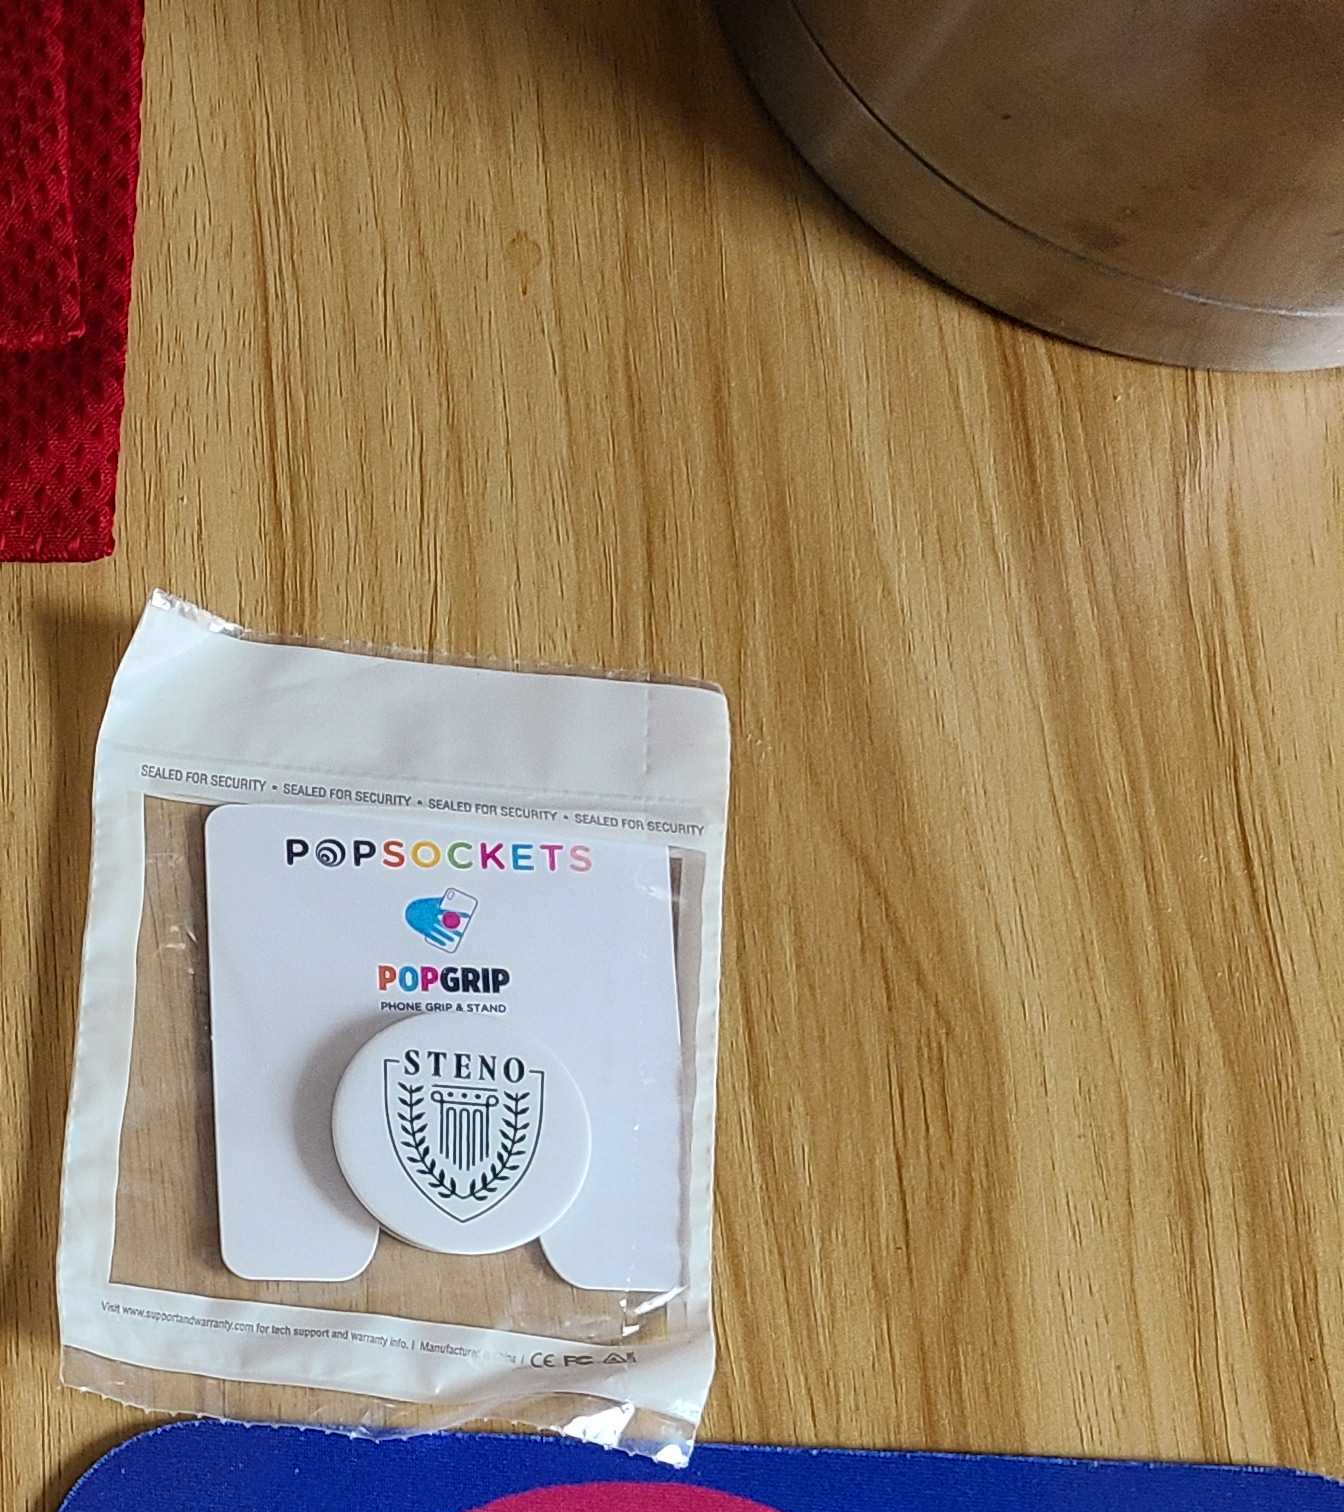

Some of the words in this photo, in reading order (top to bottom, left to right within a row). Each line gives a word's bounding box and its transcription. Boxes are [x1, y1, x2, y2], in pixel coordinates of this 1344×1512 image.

[141, 764, 183, 781] SEALED
[186, 772, 208, 785] FOR
[210, 774, 266, 792] SECURITY
[283, 784, 327, 798] SEALED
[329, 788, 352, 801] FOR
[354, 791, 412, 808] SECURITY
[428, 798, 472, 813] SEALED
[475, 803, 498, 816] FOR
[501, 805, 558, 821] SECURITY
[575, 813, 618, 828] SEALED
[621, 817, 645, 830] FOR
[647, 820, 705, 836] SECURITY
[285, 838, 592, 872] POPSOCKETS
[377, 965, 510, 993] POPGRIP
[381, 1001, 421, 1012] PHONE
[425, 1002, 453, 1012] GRIP
[456, 1003, 463, 1012] &
[467, 1003, 506, 1013] STAND
[404, 1049, 525, 1084] STENO
[101, 1301, 121, 1314] Visit
[122, 1306, 254, 1333] www.supportandwarranty.com
[256, 1323, 269, 1334] for
[271, 1325, 291, 1336] tech
[294, 1328, 329, 1340] support
[331, 1330, 348, 1340] and
[351, 1332, 388, 1347] warranty
